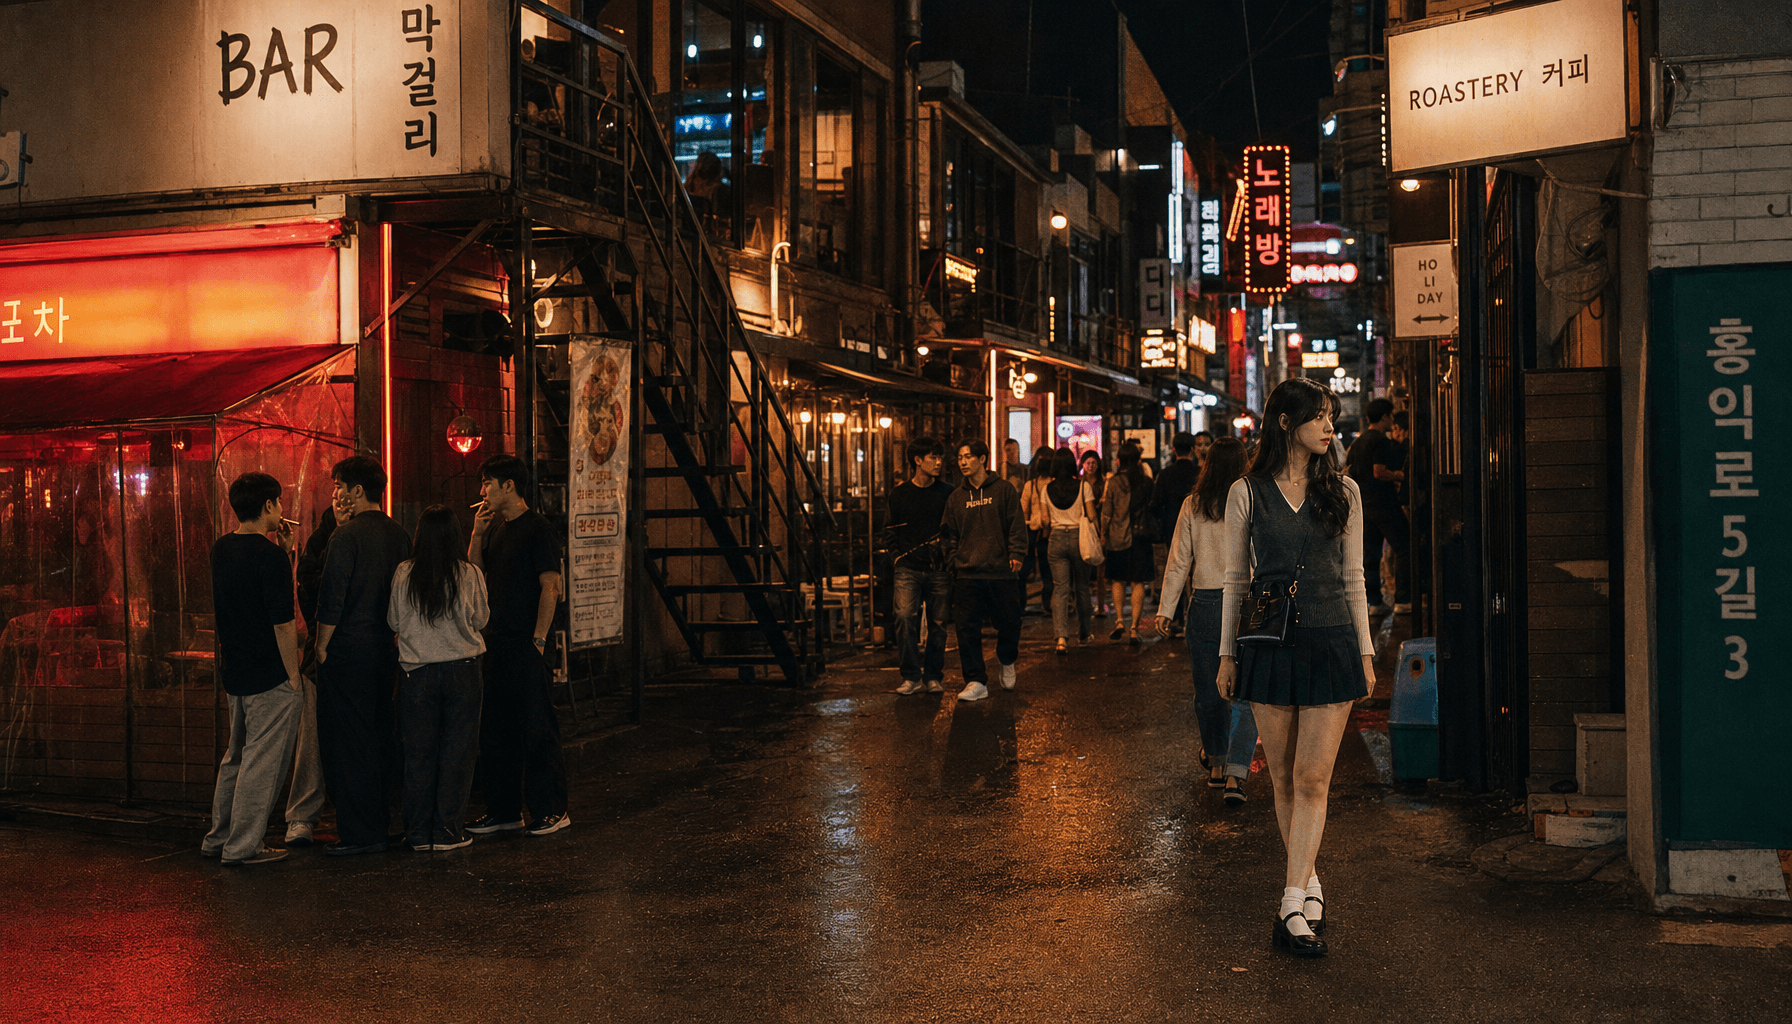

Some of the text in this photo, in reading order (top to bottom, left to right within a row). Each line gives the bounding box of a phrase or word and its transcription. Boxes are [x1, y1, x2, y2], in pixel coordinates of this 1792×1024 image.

[216, 24, 343, 106] BAR
[401, 3, 441, 158] 막걸리
[1409, 53, 1589, 111] ROASTERY 커피
[1254, 159, 1282, 266] 노래방
[1418, 259, 1438, 271] HO
[1424, 276, 1435, 287] LI
[1417, 291, 1443, 304] DAY
